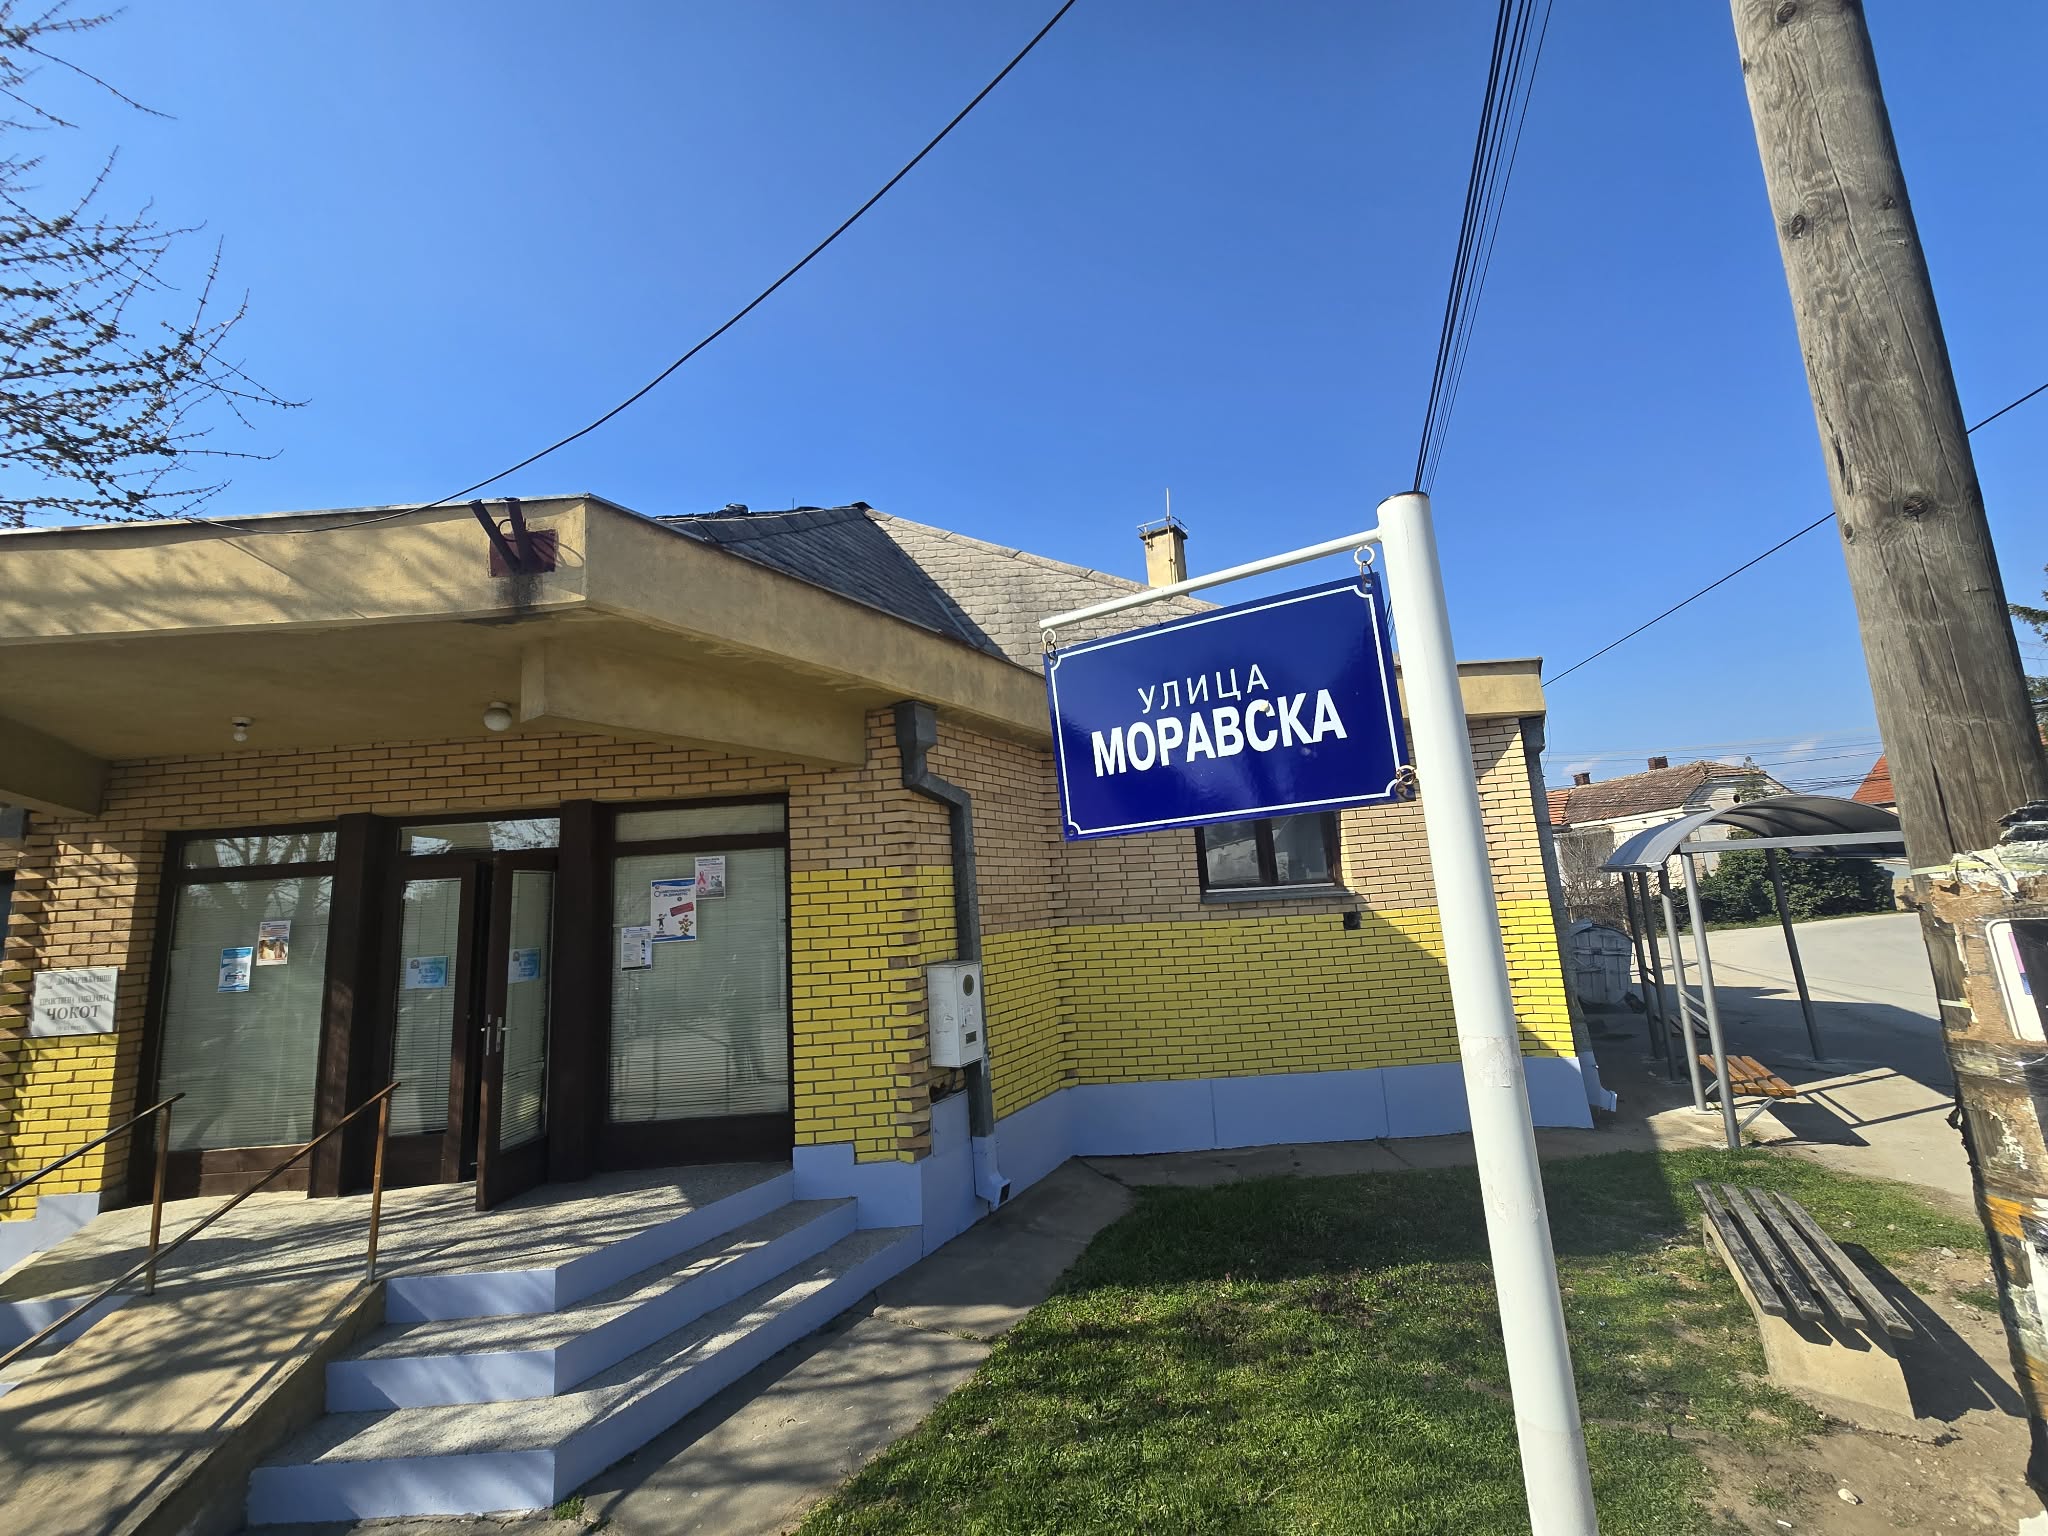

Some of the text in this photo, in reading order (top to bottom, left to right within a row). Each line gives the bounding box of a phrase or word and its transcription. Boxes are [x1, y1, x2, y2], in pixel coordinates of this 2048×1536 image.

[1137, 663, 1269, 715] УЛИЦА
[1091, 688, 1348, 778] МОРАВСКА
[47, 1004, 101, 1021] ЧОКОТ
